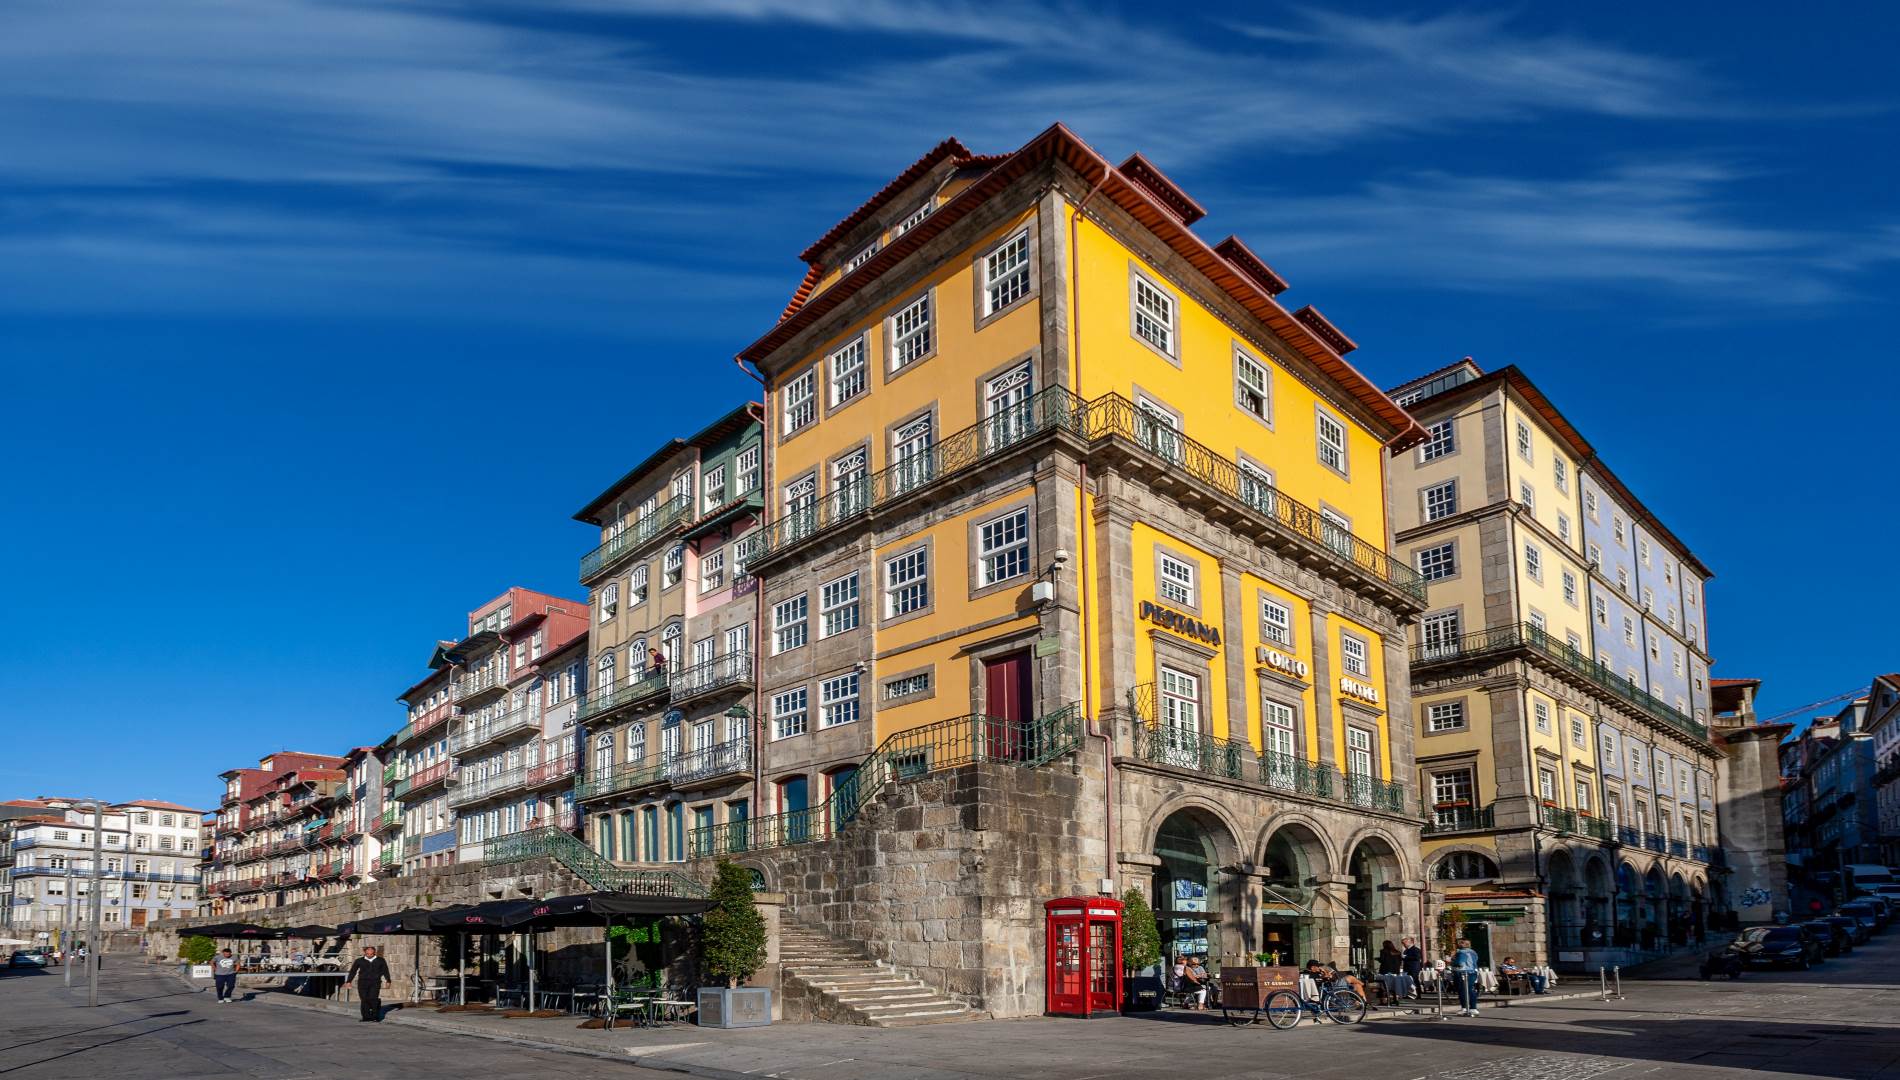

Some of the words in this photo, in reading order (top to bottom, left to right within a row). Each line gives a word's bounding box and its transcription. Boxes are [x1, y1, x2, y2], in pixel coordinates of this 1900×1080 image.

[1139, 600, 1221, 647] PESTANA
[1255, 645, 1308, 678] PORTO
[1340, 677, 1378, 705] HOTEL
